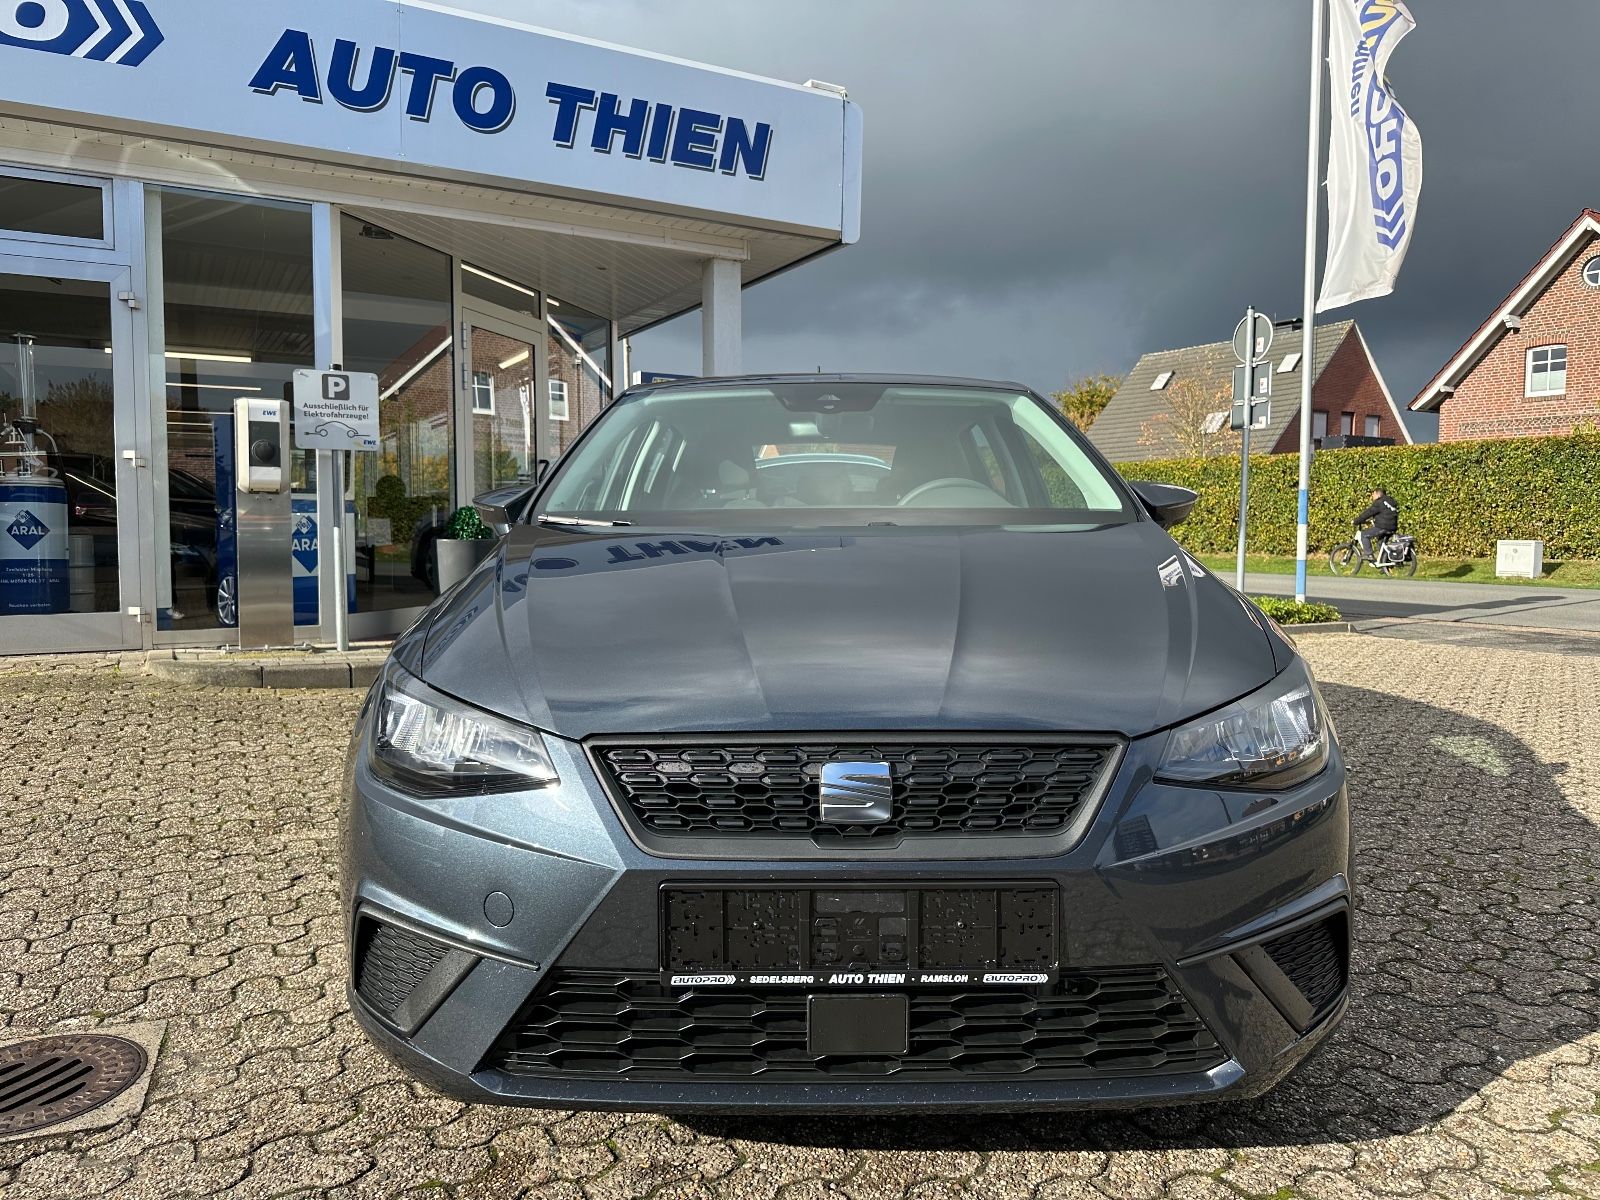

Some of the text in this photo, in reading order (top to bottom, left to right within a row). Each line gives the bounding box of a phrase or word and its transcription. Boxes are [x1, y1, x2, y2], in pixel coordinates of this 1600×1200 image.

[248, 29, 773, 182] AUTO THIEN
[303, 402, 369, 412] Ausschließlich für
[303, 410, 369, 421] Elektrofahrzeuge!
[11, 525, 45, 536] ARAL
[749, 975, 815, 984] SEDELSBERG
[828, 973, 864, 984] AUTO
[867, 973, 906, 984] THIEN
[920, 974, 969, 983] RAMSLOH
